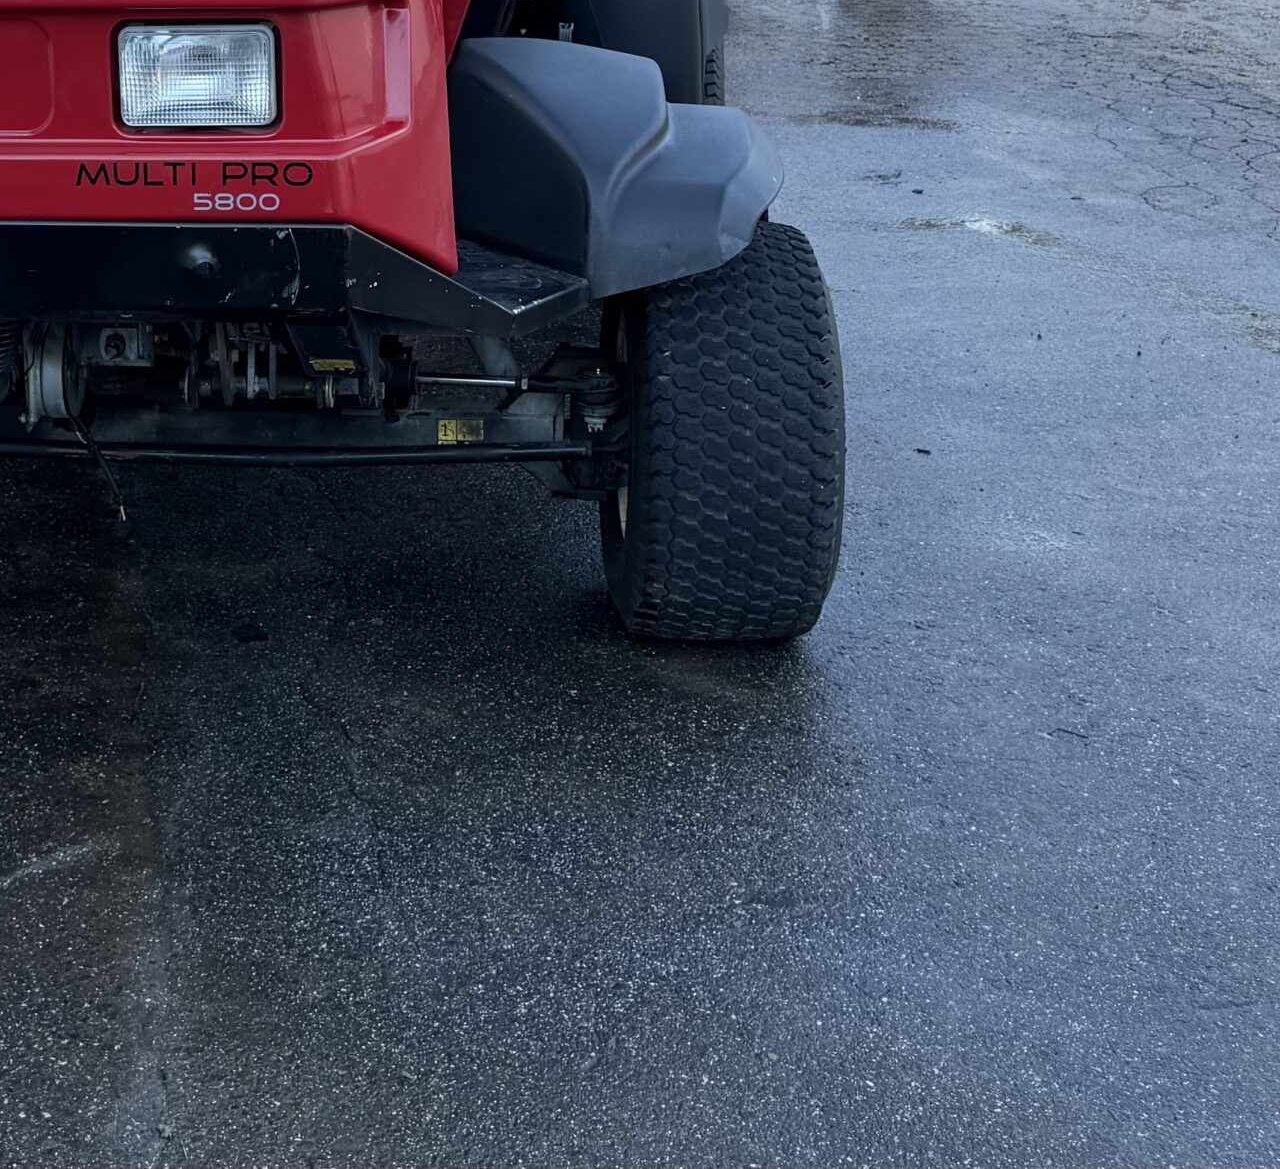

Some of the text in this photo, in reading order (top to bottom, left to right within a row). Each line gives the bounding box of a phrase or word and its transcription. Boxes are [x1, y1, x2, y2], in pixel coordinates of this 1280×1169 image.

[75, 161, 313, 187] MULTI PRO
[193, 192, 280, 211] 5800
